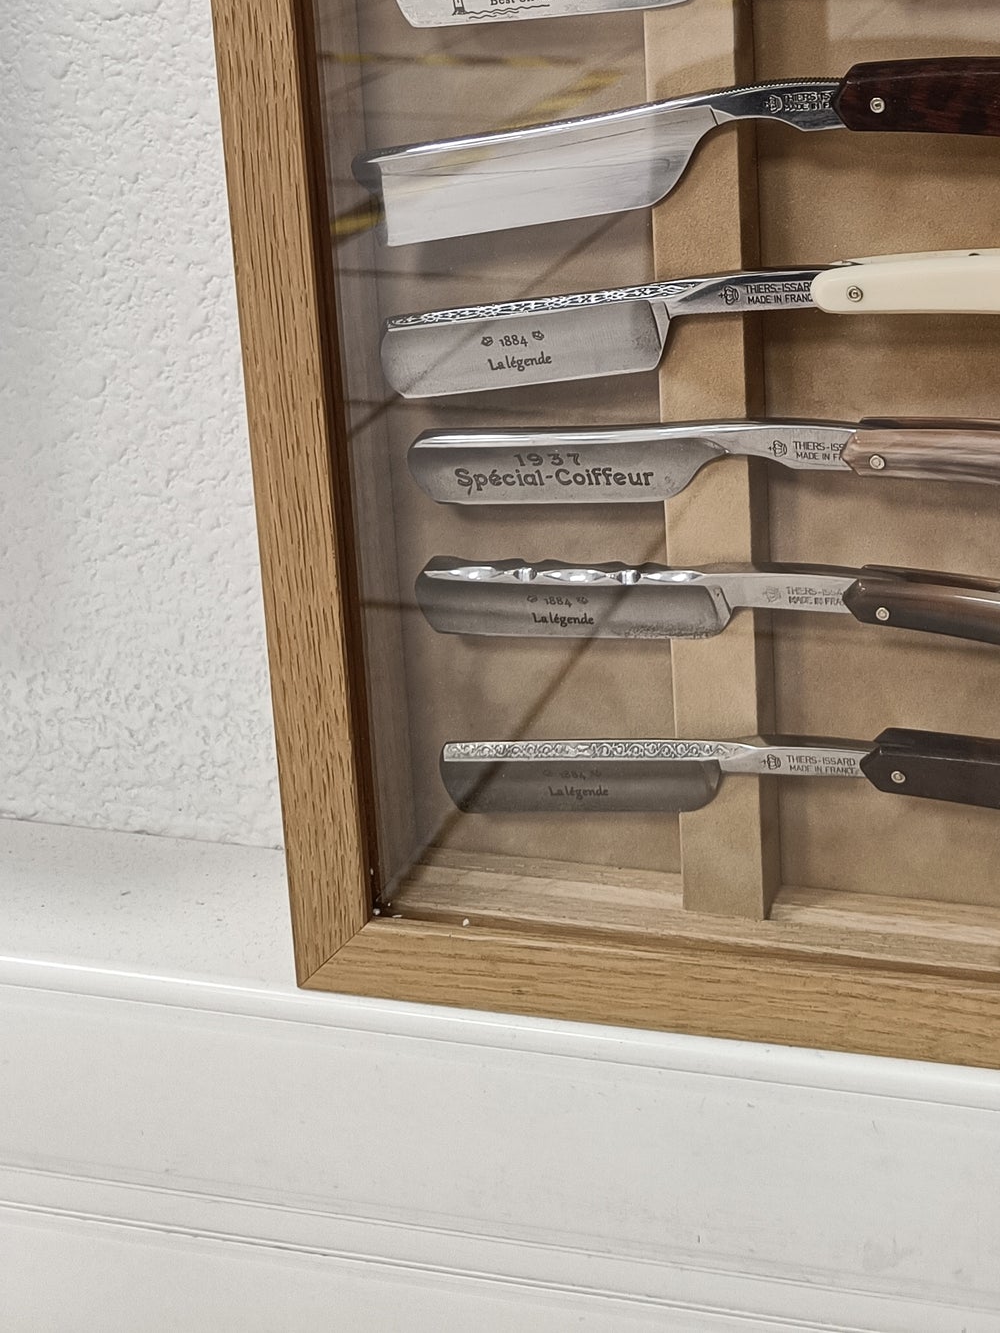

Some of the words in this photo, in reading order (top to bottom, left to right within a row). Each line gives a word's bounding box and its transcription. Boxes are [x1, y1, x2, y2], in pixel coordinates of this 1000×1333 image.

[745, 282, 812, 294] THIERS-ISSAR
[747, 296, 771, 304] MADE
[774, 294, 782, 303] IN
[785, 293, 813, 303] FRANC
[499, 334, 528, 347] 1884
[487, 358, 505, 371] La
[505, 351, 553, 372] légende
[793, 441, 844, 452] THIERS-ISS
[514, 452, 581, 467] 1937
[796, 452, 820, 460] MADE
[822, 453, 830, 461] IN
[454, 467, 654, 495] Spécial-Coiffeur
[544, 596, 573, 608] 1884
[531, 612, 548, 624] La
[549, 611, 595, 627] légende
[786, 755, 857, 766] THIERS-ISSARD
[789, 764, 810, 772] MADE
[548, 786, 564, 796] La
[565, 785, 608, 800] légende
